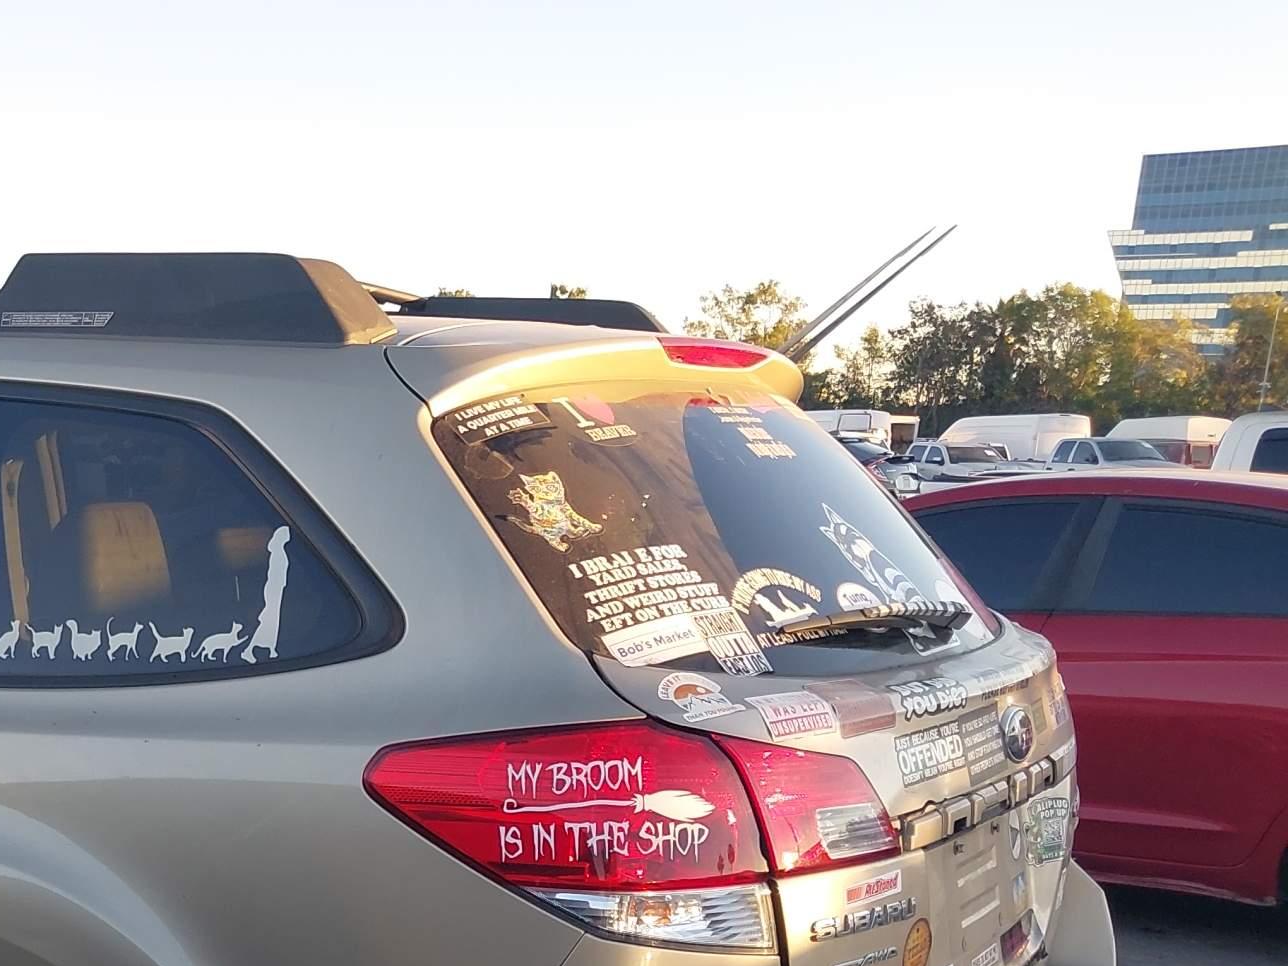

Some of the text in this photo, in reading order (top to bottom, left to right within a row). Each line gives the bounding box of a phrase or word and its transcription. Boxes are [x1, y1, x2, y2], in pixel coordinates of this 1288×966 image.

[457, 425, 469, 434] A
[466, 408, 515, 430] QUARTER
[460, 404, 484, 418] LIVE
[484, 400, 502, 413] MY
[484, 416, 533, 437] AT A TIME
[585, 424, 637, 442] BEAVER
[568, 563, 584, 579] I
[651, 544, 688, 561] FOR
[584, 570, 702, 605] THRIFT STORES
[588, 567, 637, 587] YARD
[586, 582, 720, 623] AND WEIRD STUFF
[634, 605, 661, 623] ON
[659, 600, 693, 617] THE
[690, 595, 730, 612] CURB
[694, 611, 745, 637] STRAIGHT
[617, 629, 696, 658] Bob's Market
[708, 635, 760, 659] OUTTA
[756, 632, 773, 649] AT
[662, 675, 682, 699] LEAVE IT
[890, 681, 930, 696] BUT
[772, 704, 796, 718] WAS
[902, 692, 938, 719] YOU
[770, 714, 833, 737] UNSUPERVISED
[896, 722, 960, 750] JUST BECAUSE YOU'RE
[898, 734, 964, 775] OFFENDED
[507, 756, 643, 799] MY BROOM
[904, 770, 924, 784] DOESN'T
[1040, 808, 1066, 820] POP UP
[499, 821, 710, 863] IS IN THE SHOP
[810, 898, 917, 943] SUBARU
